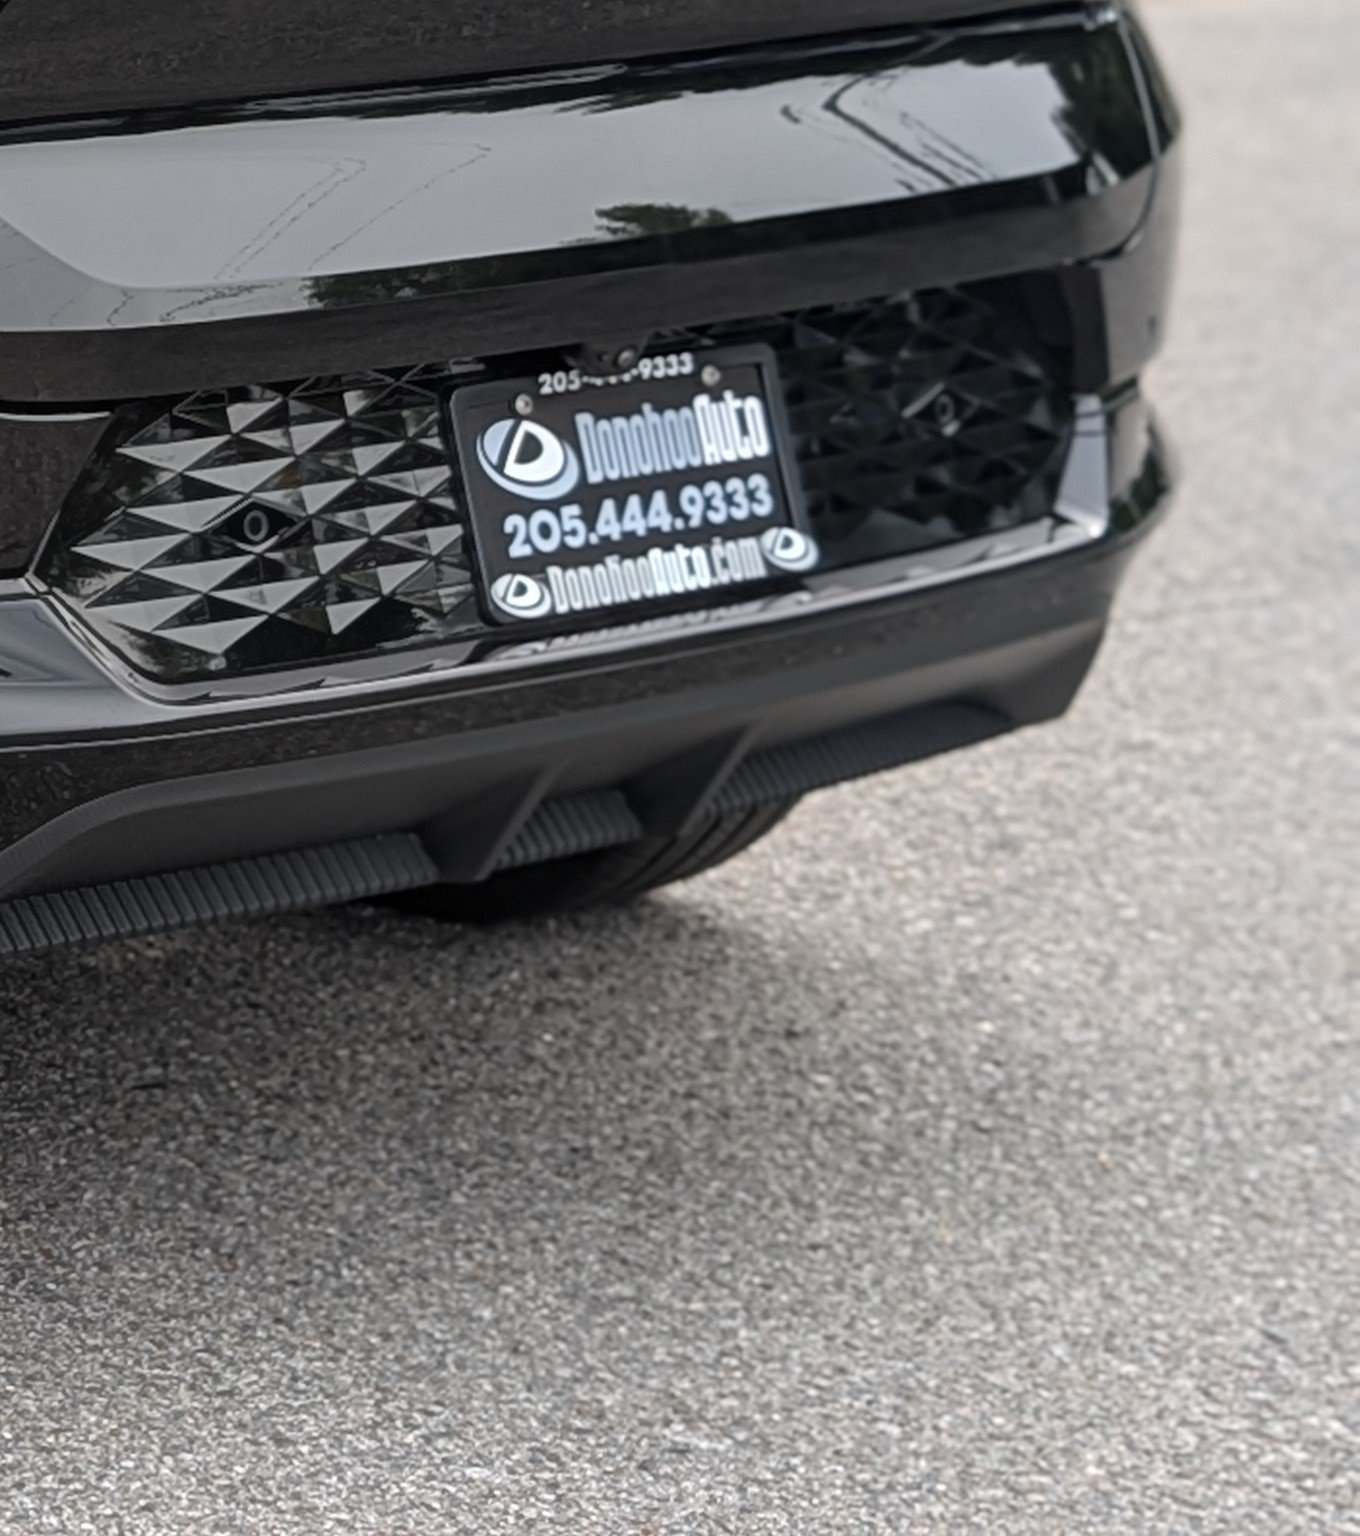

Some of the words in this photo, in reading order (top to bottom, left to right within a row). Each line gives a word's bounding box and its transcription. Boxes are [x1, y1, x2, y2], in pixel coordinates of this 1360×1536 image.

[538, 352, 695, 395] 205--9333
[575, 389, 771, 484] DonohooAuto
[503, 473, 774, 558] 205.444.9333
[546, 536, 768, 614] DonohooAuto.com
